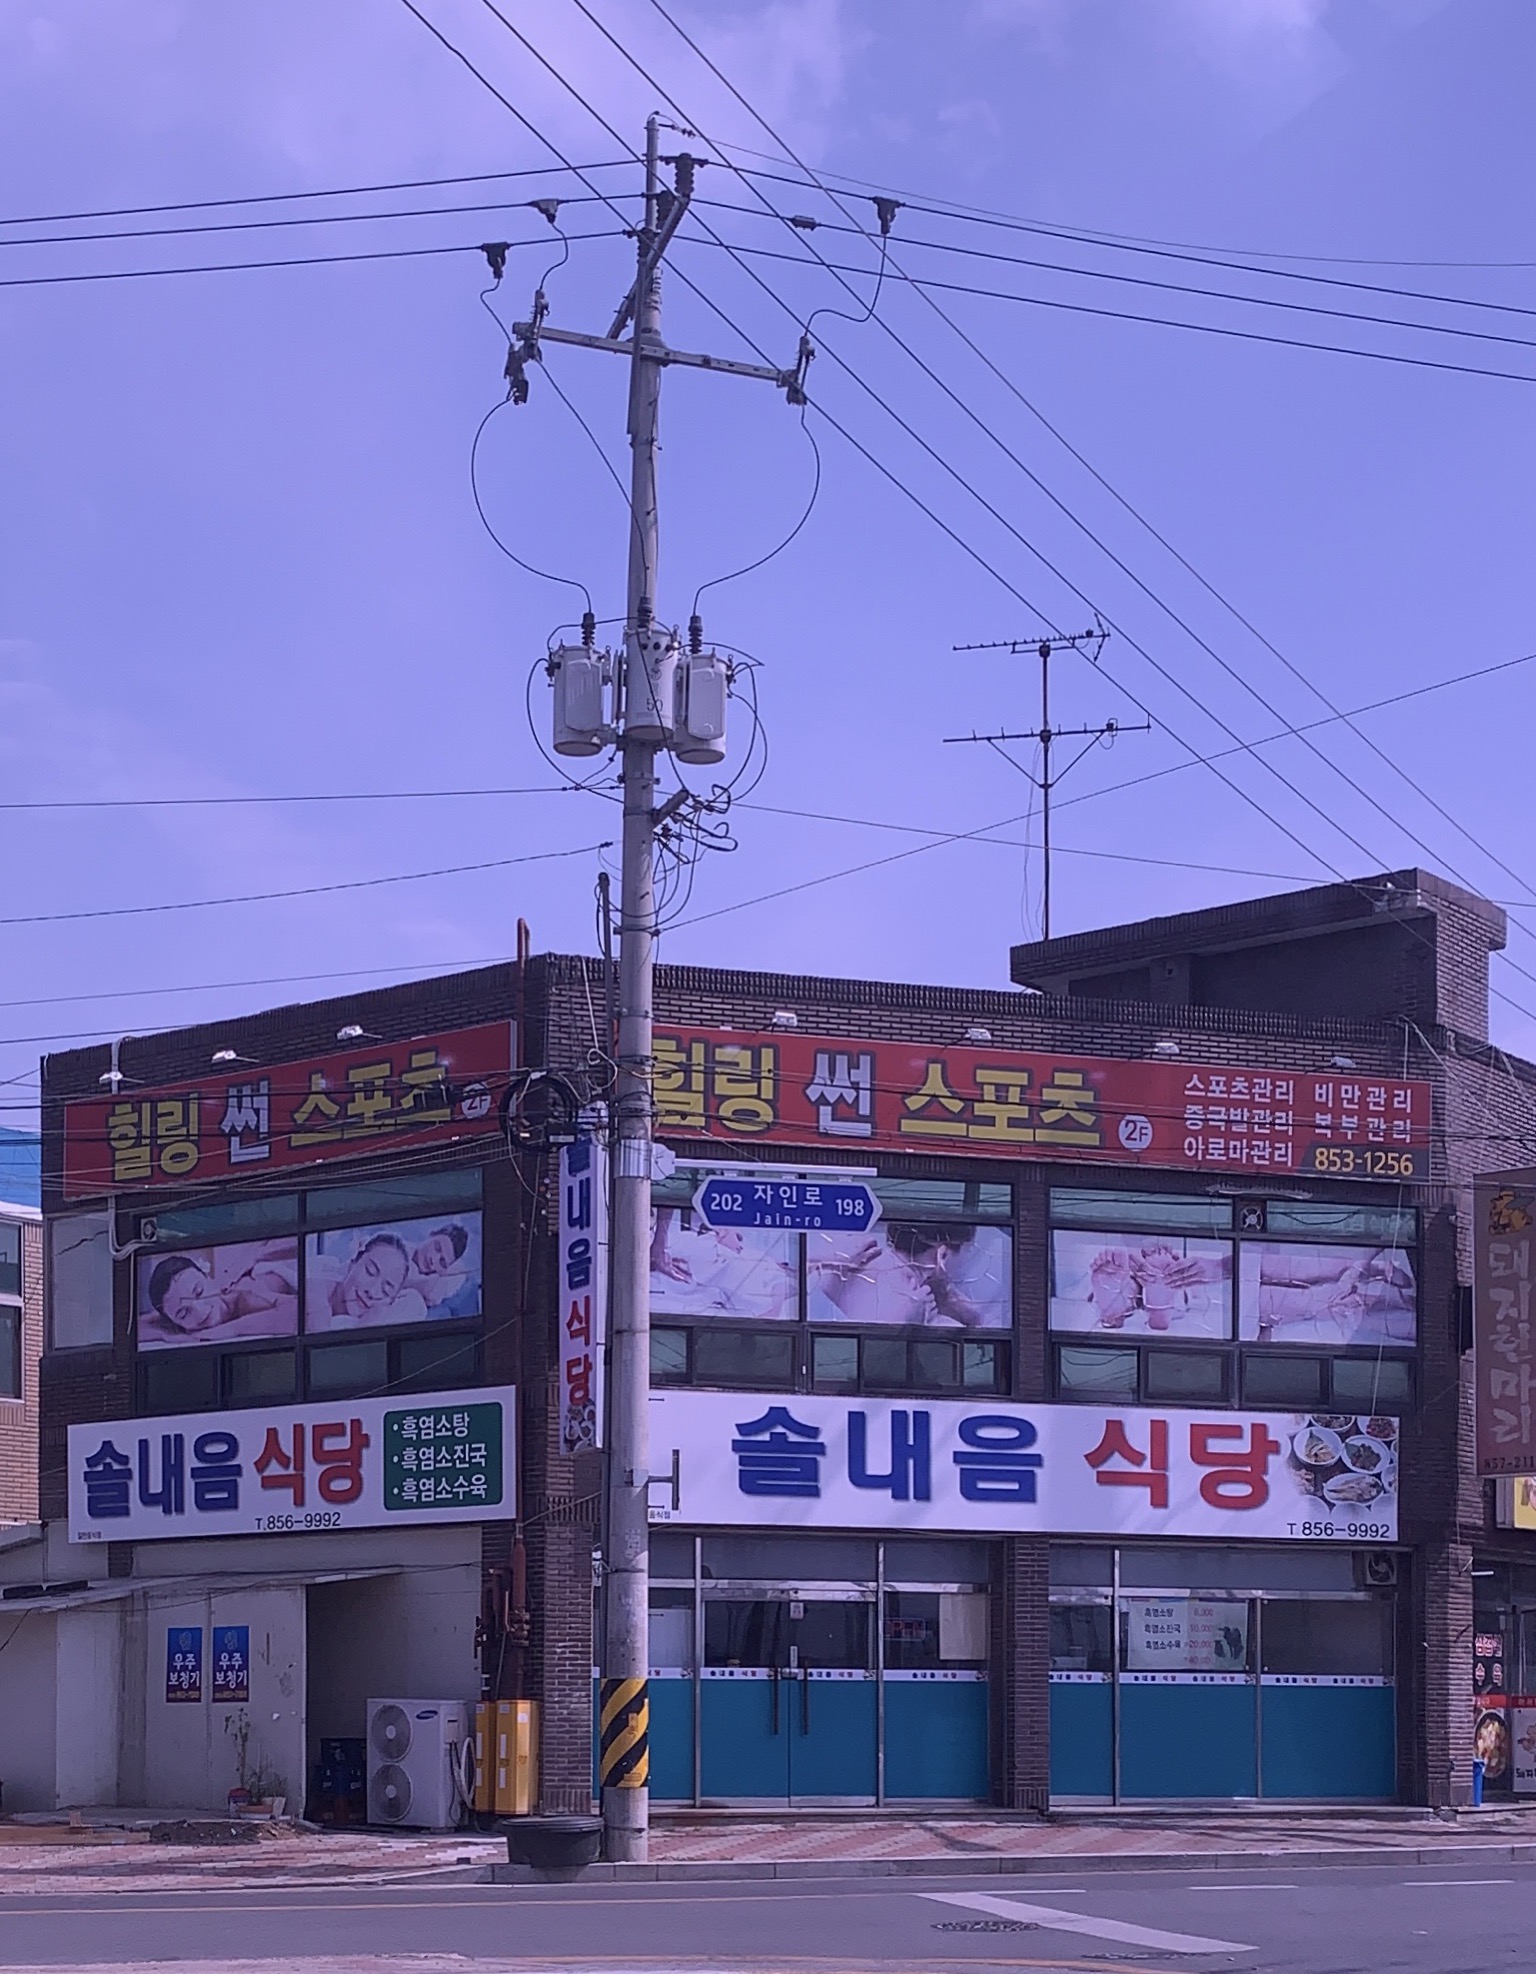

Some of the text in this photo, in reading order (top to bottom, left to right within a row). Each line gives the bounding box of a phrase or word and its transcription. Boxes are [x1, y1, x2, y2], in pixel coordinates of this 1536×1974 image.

[652, 1038, 1101, 1147] 힐링 썬 스포츠
[1184, 1073, 1411, 1113] 스포츠관리 비만관리
[108, 1049, 452, 1182] 힐링 썬 스포츠
[1183, 1104, 1411, 1143] 중국발관리 복부관리
[1123, 1119, 1150, 1143] 2F
[1184, 1136, 1413, 1176] 아로마관리 853-1256
[710, 1192, 743, 1212] 202
[753, 1184, 823, 1209] 자인로
[835, 1199, 865, 1217] 198
[753, 1212, 821, 1227] Jain-ro
[566, 1296, 593, 1407] 식당
[401, 1412, 470, 1440] 흑염소탕
[83, 1418, 371, 1518] 솔내음 식당
[401, 1443, 487, 1472] 흑염소진국
[731, 1406, 1281, 1511] 솔내음 식당
[401, 1474, 487, 1502] 흑염소수육
[1301, 1521, 1390, 1539] 856-9992
[173, 1653, 197, 1670] 우주
[219, 1652, 243, 1670] 우주
[168, 1671, 200, 1689] 보청기
[214, 1670, 248, 1689] 보청기
